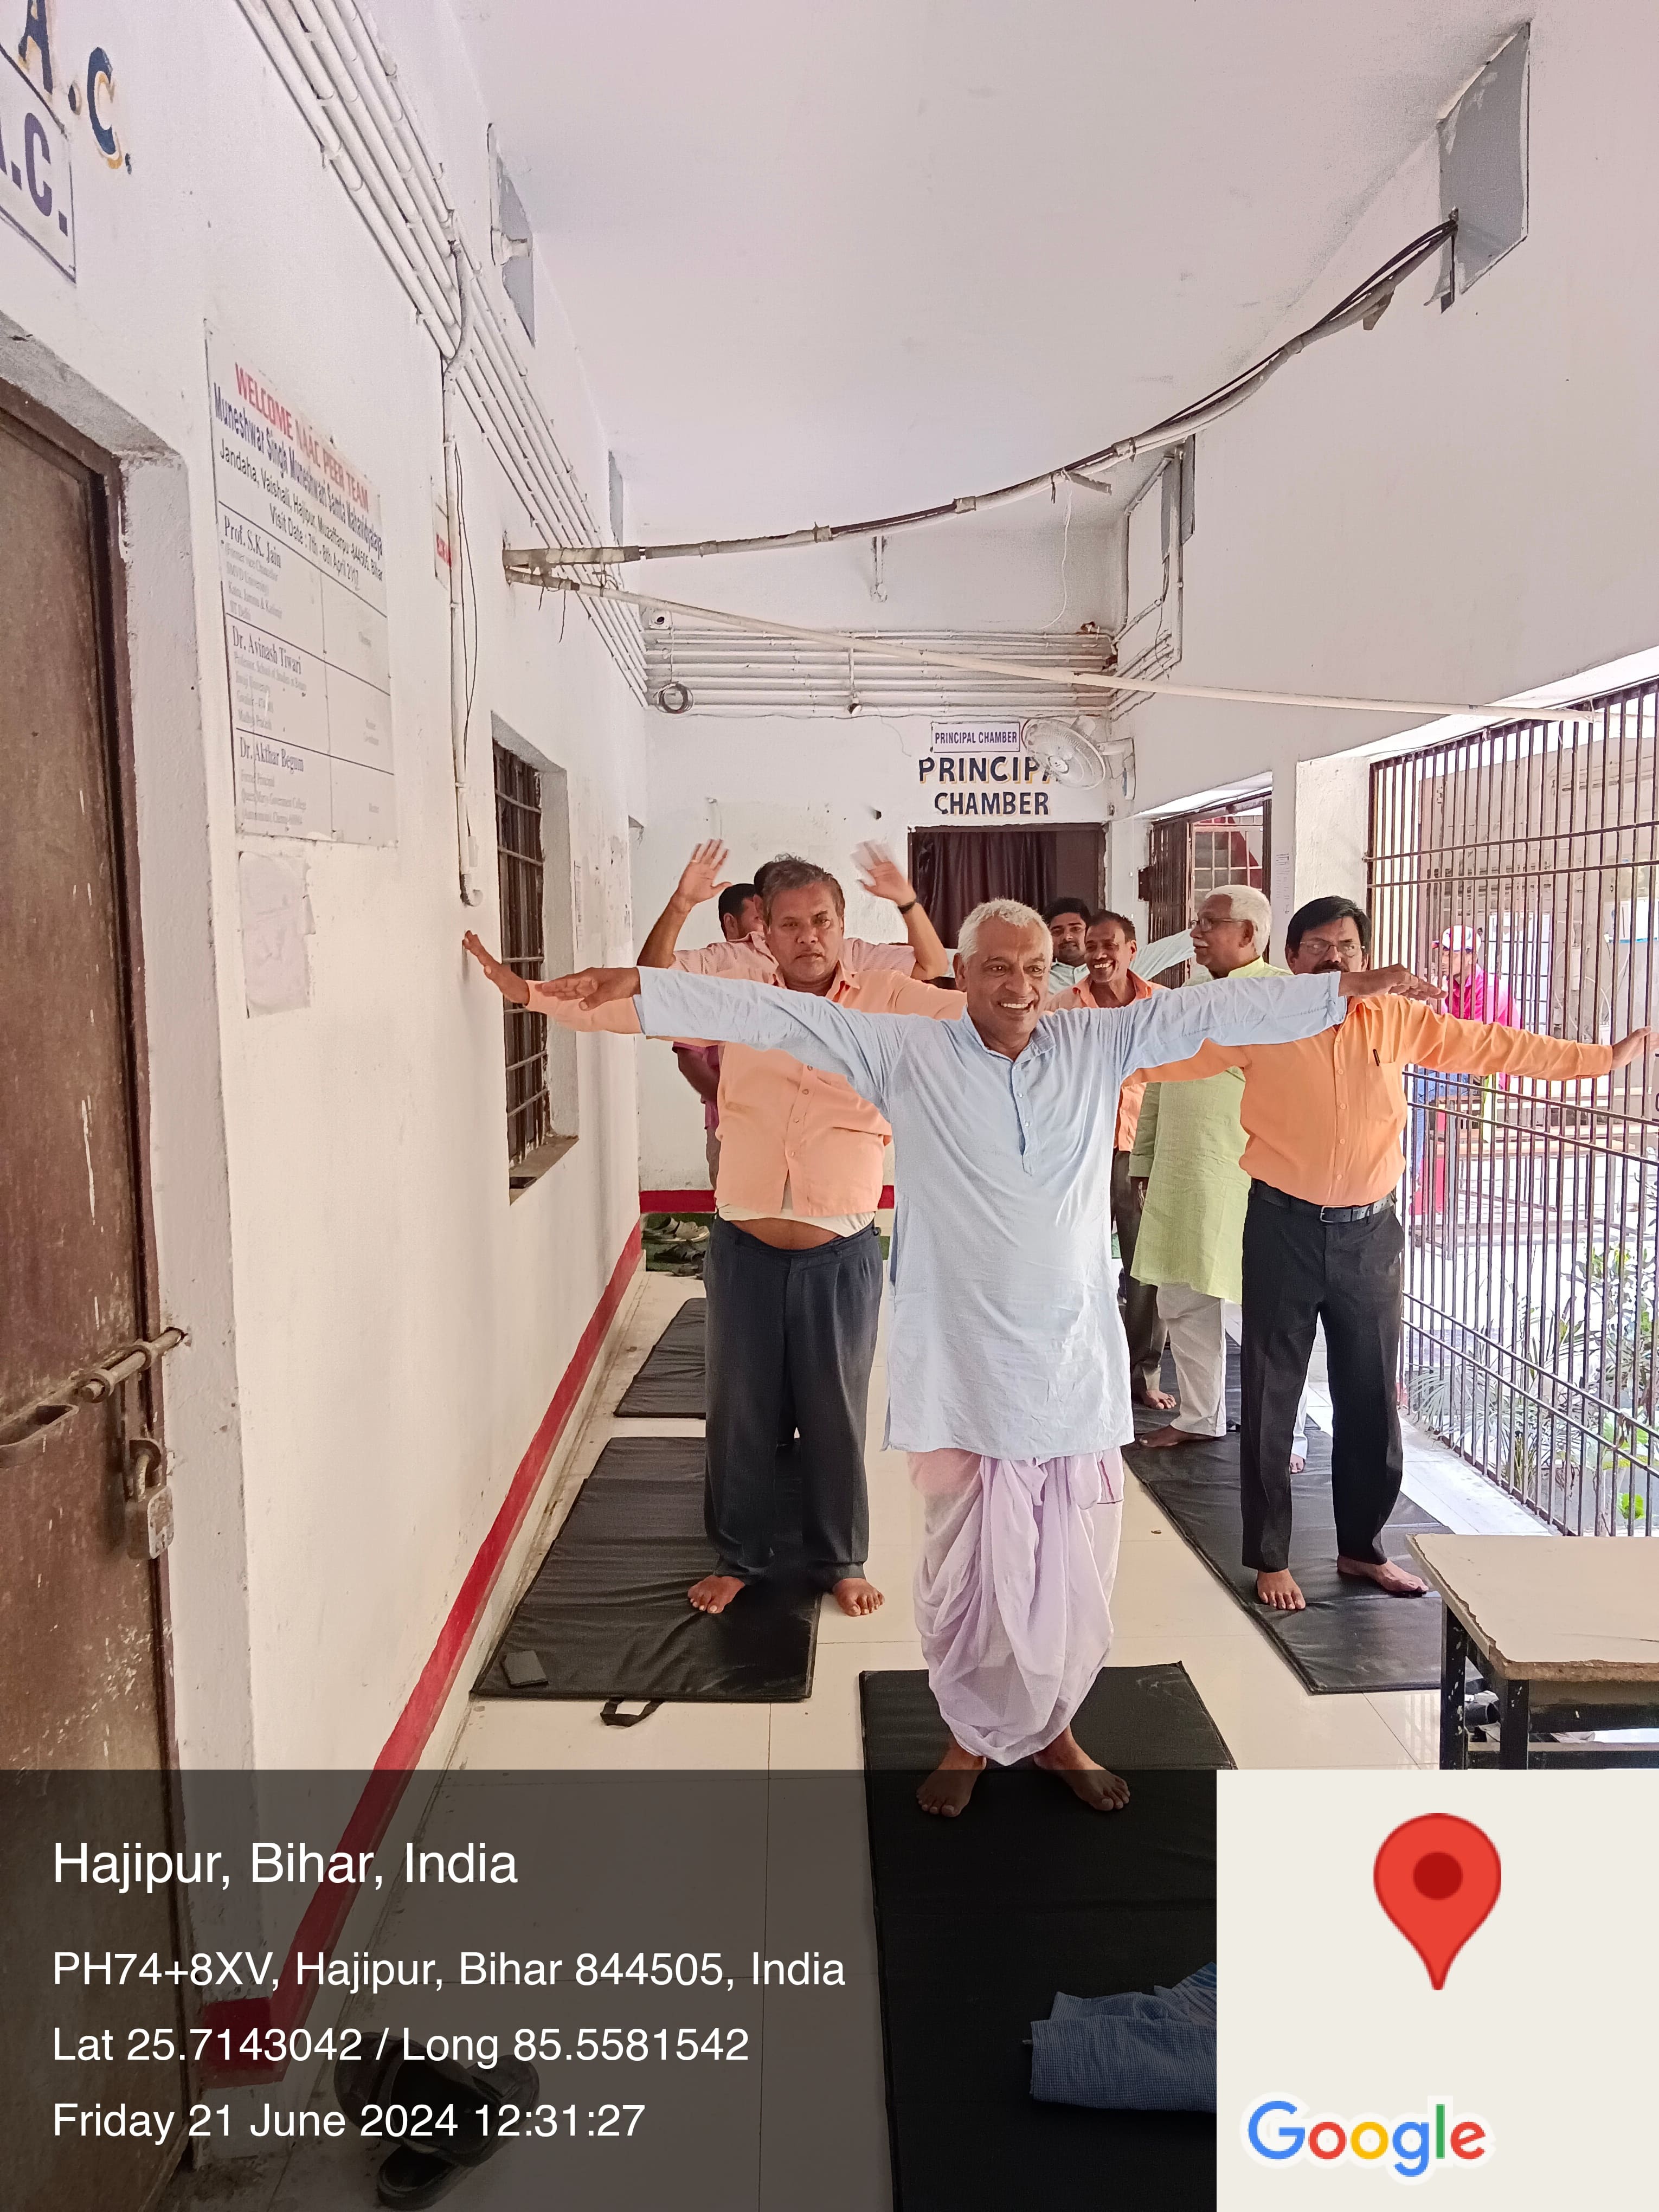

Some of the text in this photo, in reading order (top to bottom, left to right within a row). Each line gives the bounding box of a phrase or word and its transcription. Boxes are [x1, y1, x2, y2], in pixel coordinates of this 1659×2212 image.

[214, 382, 264, 454] Muneshwar
[235, 362, 369, 514] WELCOME NAAC PEER TEAM
[220, 438, 260, 488] Jandaha,
[224, 516, 246, 546] Prof.
[247, 529, 264, 558] S.K.
[266, 541, 281, 568] Jain
[269, 503, 287, 533] Visit
[288, 517, 303, 544] Date
[233, 626, 246, 651] Dr.
[248, 633, 278, 665] Avinash
[279, 646, 301, 675] Tiwari
[240, 737, 253, 759] Dr.
[935, 731, 1018, 744] PRINCIPAL CHAMBER
[934, 792, 1050, 815] CHAMBER
